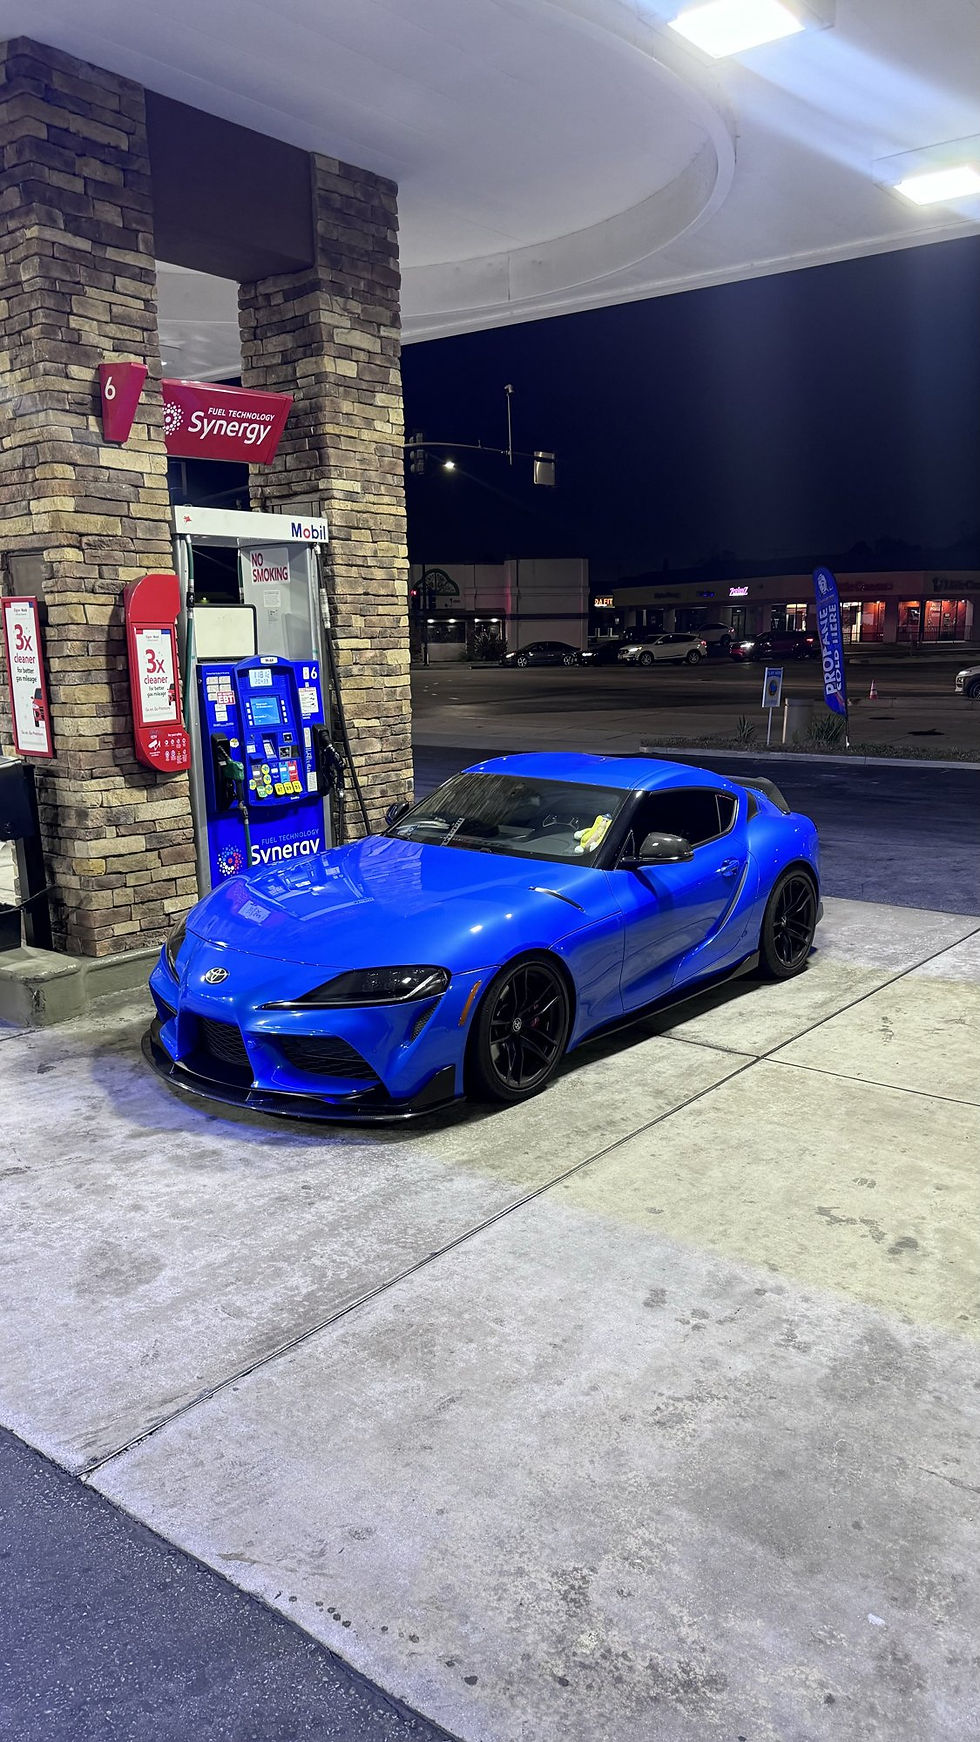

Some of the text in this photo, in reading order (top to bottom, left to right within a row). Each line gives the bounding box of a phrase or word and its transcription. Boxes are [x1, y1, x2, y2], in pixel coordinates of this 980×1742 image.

[104, 376, 116, 400] 6
[207, 407, 275, 422] FUEL TECHNOLOGY
[187, 411, 272, 445] Synergy
[291, 522, 326, 540] Mobil
[251, 552, 263, 567] NO
[252, 566, 288, 583] SMOKING
[14, 624, 33, 651] 3x
[819, 606, 837, 695] PROPANE
[828, 603, 842, 691] SOLD HERE
[14, 652, 36, 664] cleaner
[145, 649, 166, 674] 3x
[144, 674, 168, 685] cleaner
[310, 666, 318, 680] 6
[218, 695, 235, 704] EBT
[261, 828, 320, 846] FUEL TECHNOLOGY
